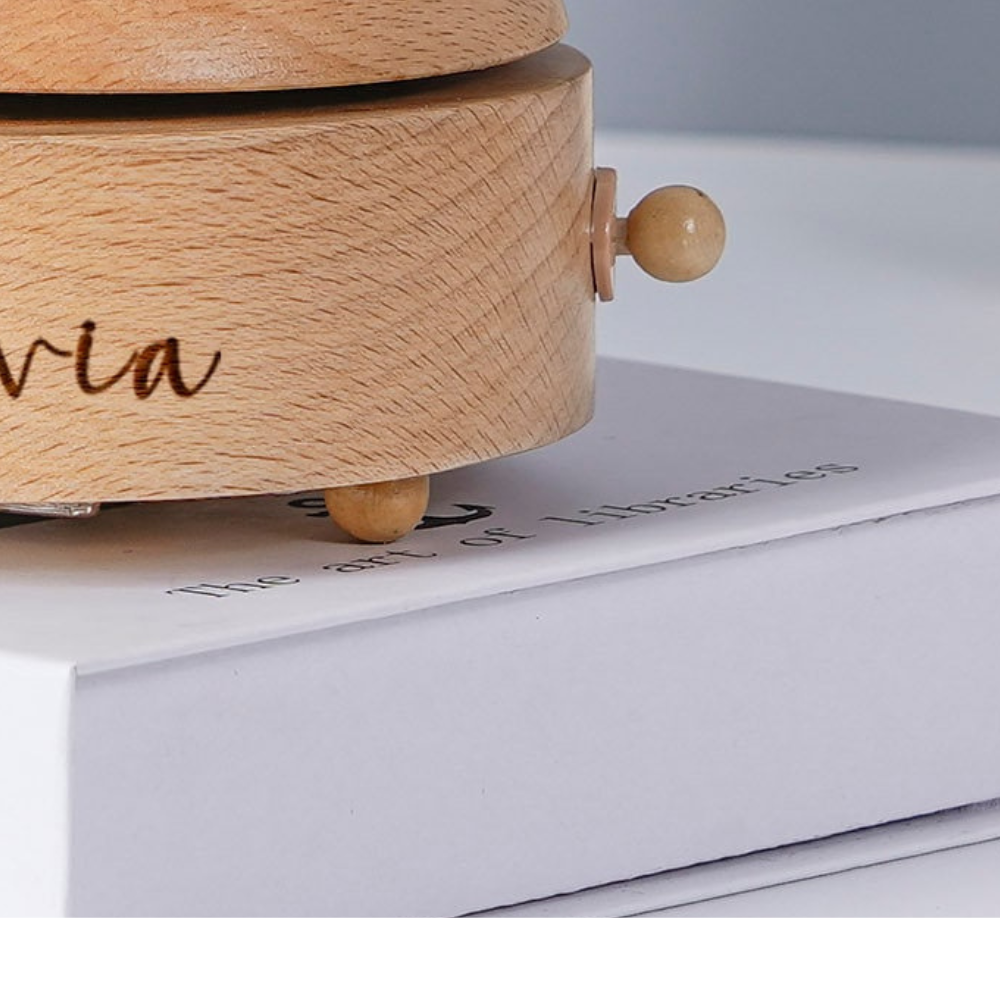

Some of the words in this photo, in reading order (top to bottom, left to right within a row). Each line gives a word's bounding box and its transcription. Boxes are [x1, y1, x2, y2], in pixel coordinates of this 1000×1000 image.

[165, 574, 300, 598] The
[322, 549, 437, 574] art
[458, 528, 537, 547] of
[538, 462, 860, 528] libraries
